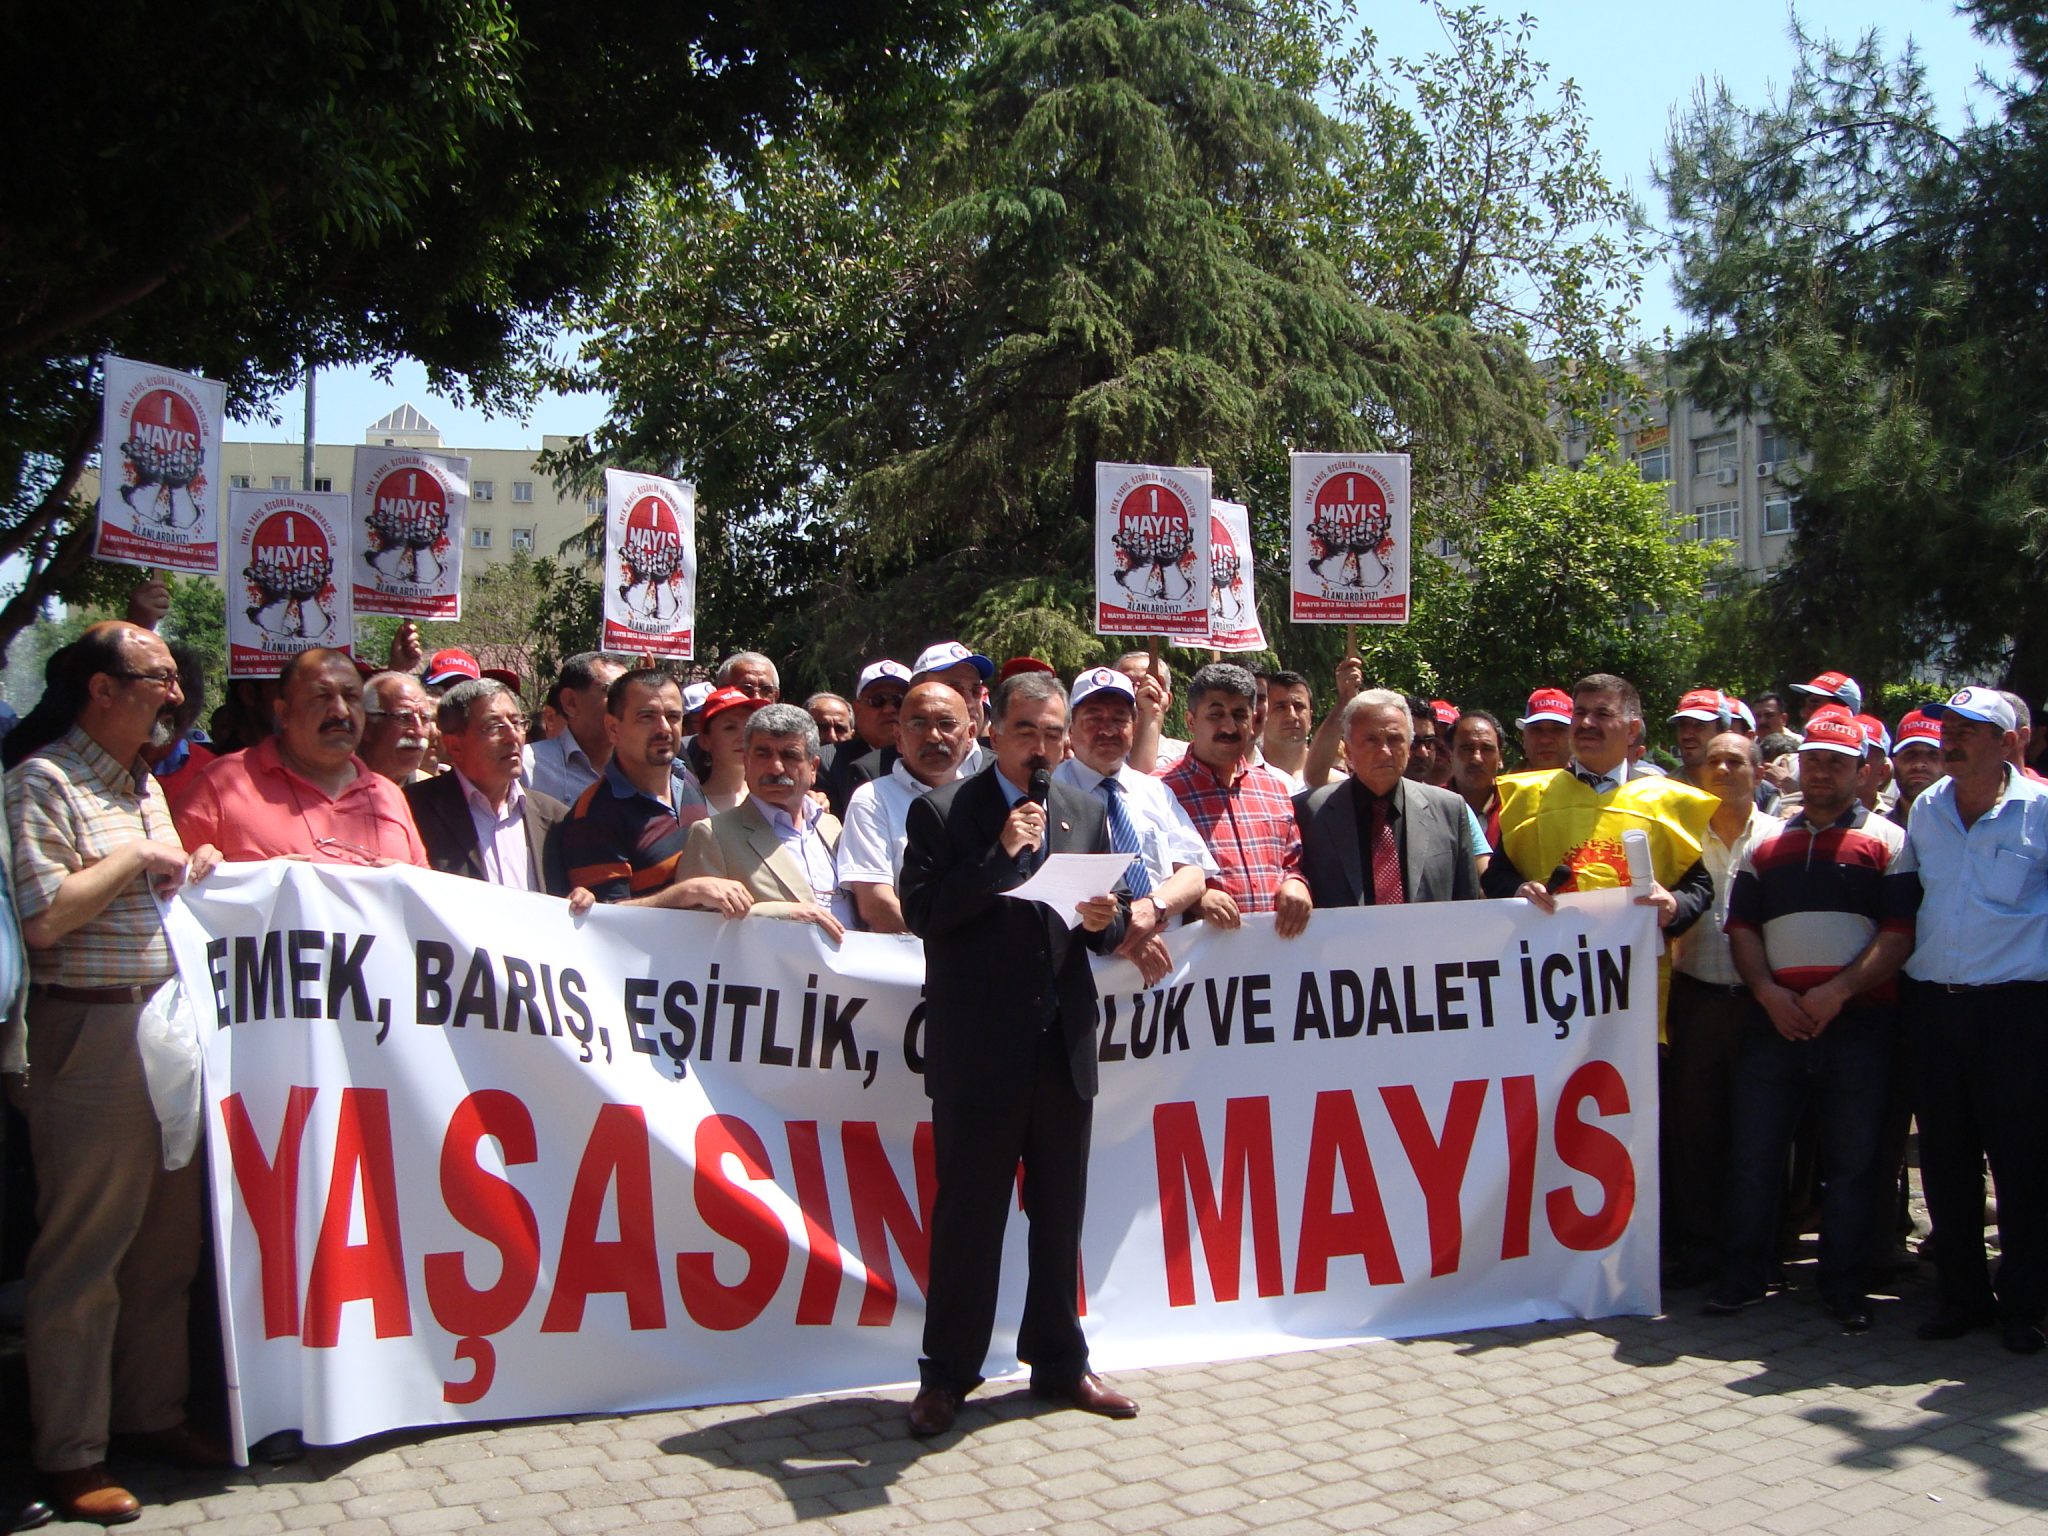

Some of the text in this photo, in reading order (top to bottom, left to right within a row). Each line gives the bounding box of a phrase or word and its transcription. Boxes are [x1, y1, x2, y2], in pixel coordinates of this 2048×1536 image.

[164, 396, 172, 424] 1
[136, 422, 195, 452] MAYIS
[1327, 460, 1356, 474] ÖZGÜRLÜK
[409, 474, 416, 496] 1
[1132, 472, 1158, 484] ÖZGÜRLÜK
[1346, 477, 1355, 501] 1
[381, 497, 439, 519] MAYIS
[1150, 489, 1158, 513] 1
[652, 502, 658, 527] 1
[1320, 504, 1380, 523] MAYIS
[132, 524, 189, 544] ALANLARDAYIZ!
[286, 517, 295, 542] 1
[1124, 515, 1183, 535] MAYIS
[630, 527, 676, 551] MAYIS
[258, 546, 322, 566] MAYIS
[1212, 543, 1232, 559] YIS
[376, 583, 432, 596] ALANLARDAYIZ!
[1322, 590, 1378, 600] ALANLARDAYIZ!
[1127, 601, 1182, 614] ALANLARDAYIZ!
[628, 619, 671, 633] ALANLARDAYIZ!
[206, 930, 392, 1046] EMEK,
[416, 940, 612, 1063] BARIŞ,
[624, 963, 880, 1090] EŞİTLİK,
[1205, 974, 1274, 1046] VE
[1294, 960, 1500, 1041] ADALET
[1518, 934, 1632, 1040] İÇİN
[220, 1085, 938, 1404] YAŞASIN
[1153, 1060, 1636, 1307] MAYIS
